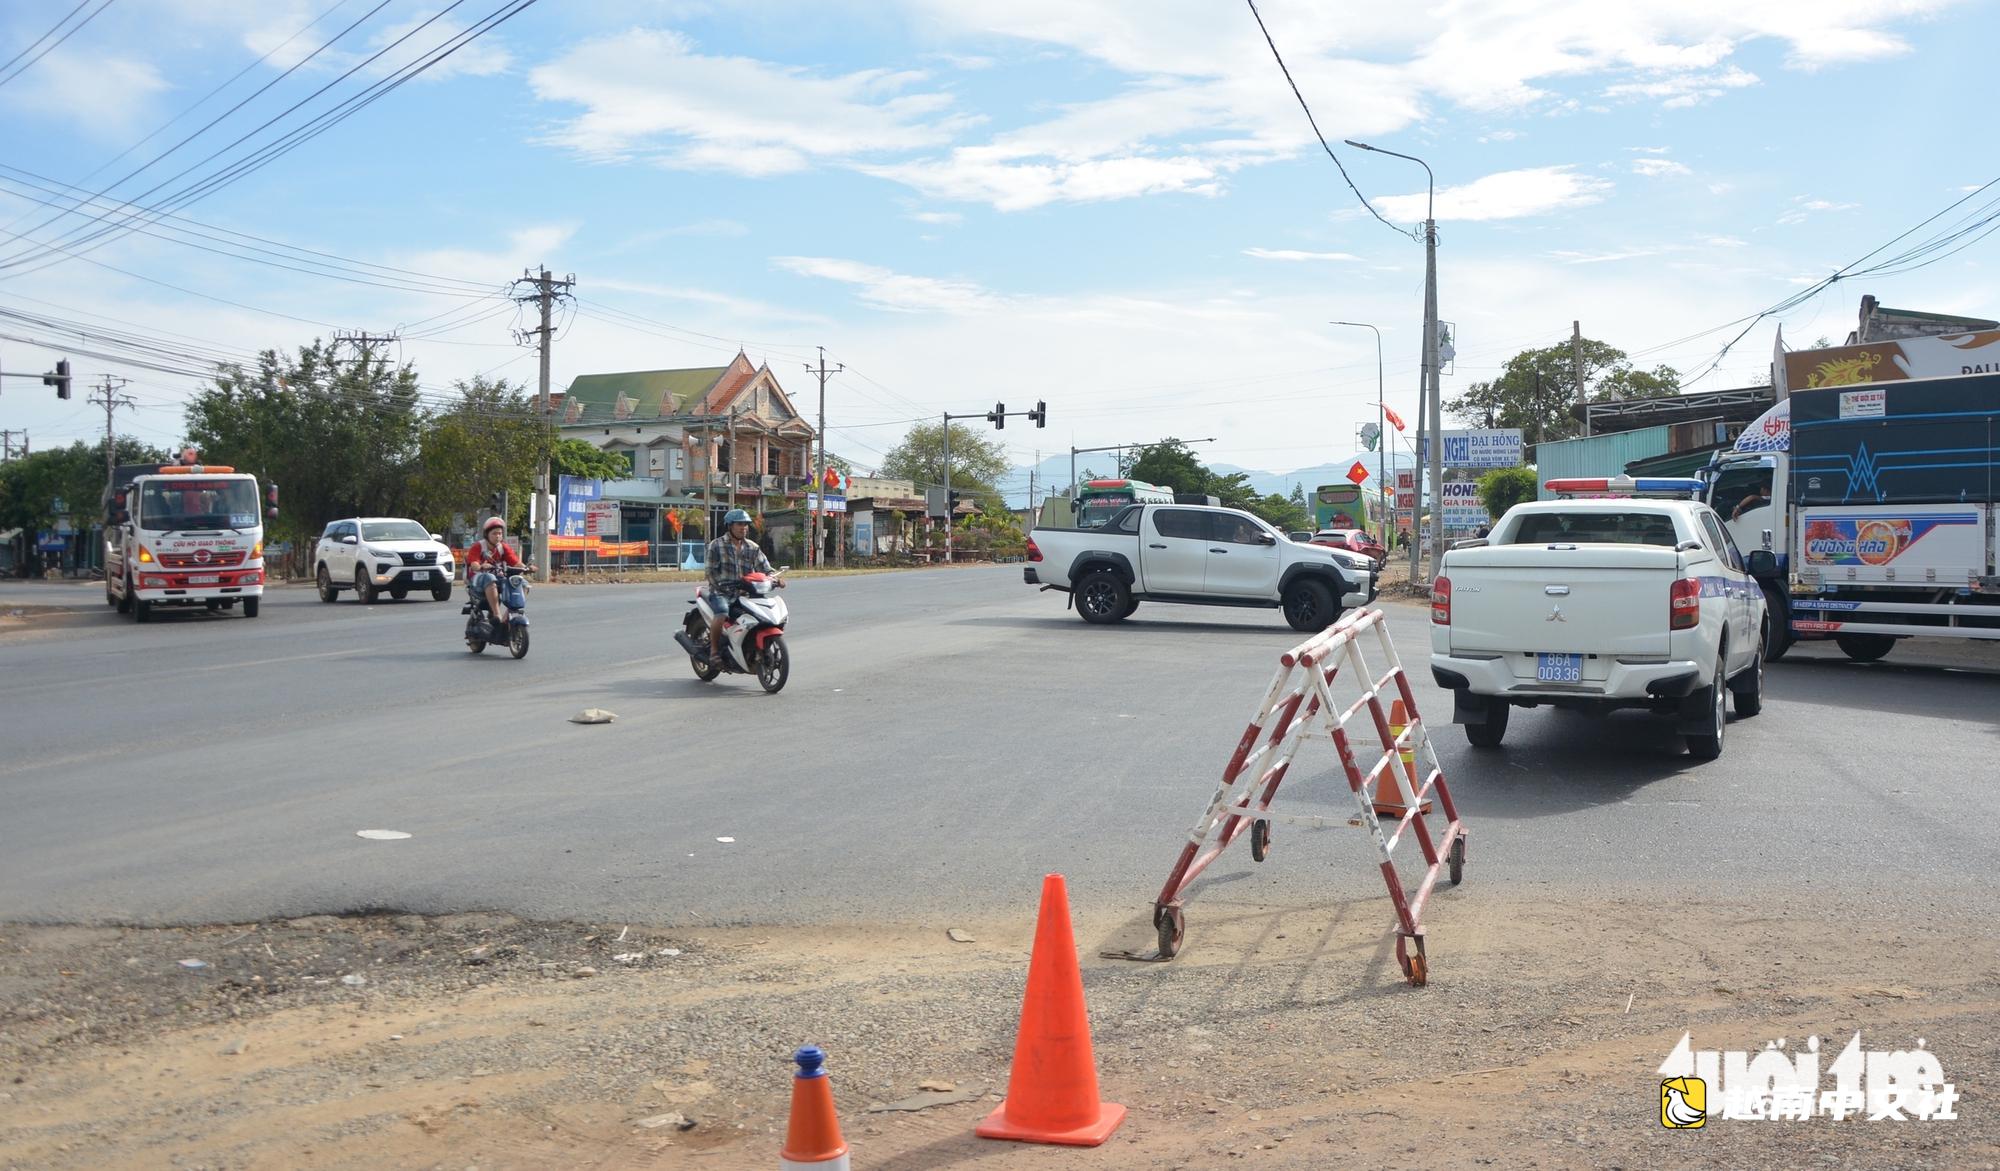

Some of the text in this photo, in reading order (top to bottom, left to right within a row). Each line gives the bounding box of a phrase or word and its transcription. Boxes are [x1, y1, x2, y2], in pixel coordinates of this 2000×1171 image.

[1830, 602, 1854, 610] DISTANCE
[1547, 653, 1571, 667] 86A
[1537, 667, 1579, 681] 003.36
